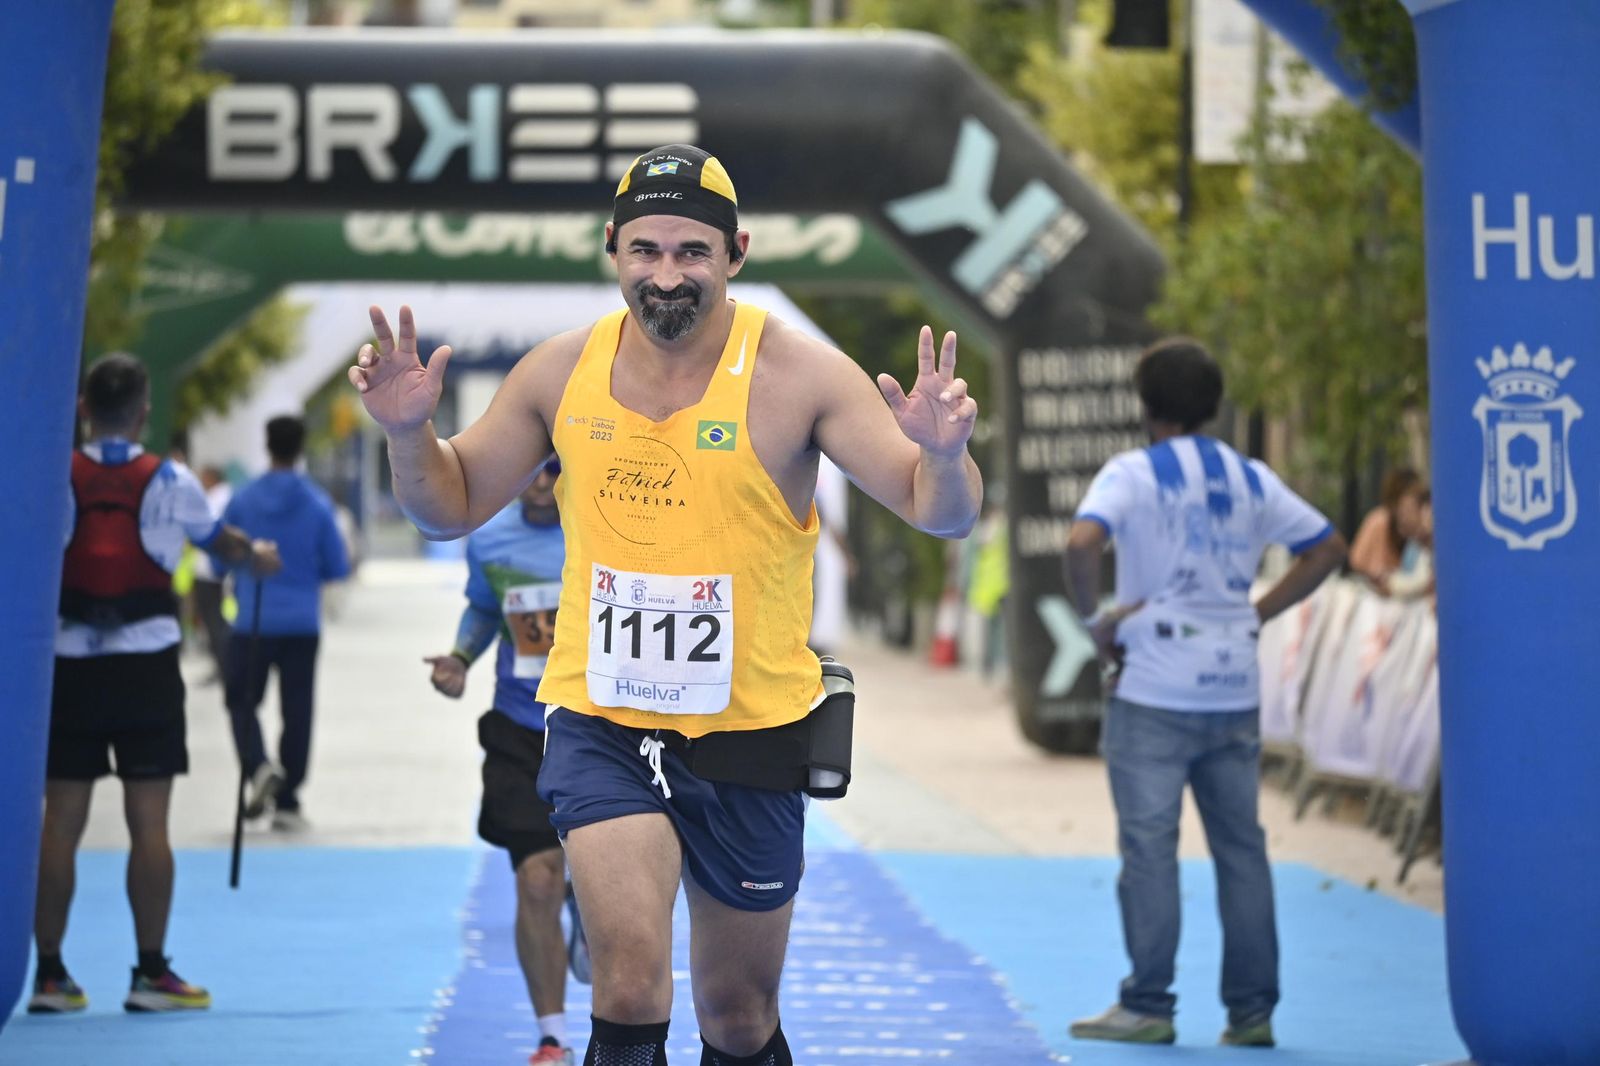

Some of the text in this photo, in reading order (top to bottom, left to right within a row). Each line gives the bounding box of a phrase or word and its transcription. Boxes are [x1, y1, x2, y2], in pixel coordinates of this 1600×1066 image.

[591, 421, 615, 431] Lisboa
[590, 430, 613, 442] 2023
[606, 467, 676, 493] Patrick
[599, 489, 686, 507] SILVEIRA
[692, 579, 722, 603] 21K
[648, 597, 676, 605] HUELVA
[691, 602, 723, 611] HUELVA
[598, 605, 721, 663] 1112
[615, 680, 680, 702] Huelva
